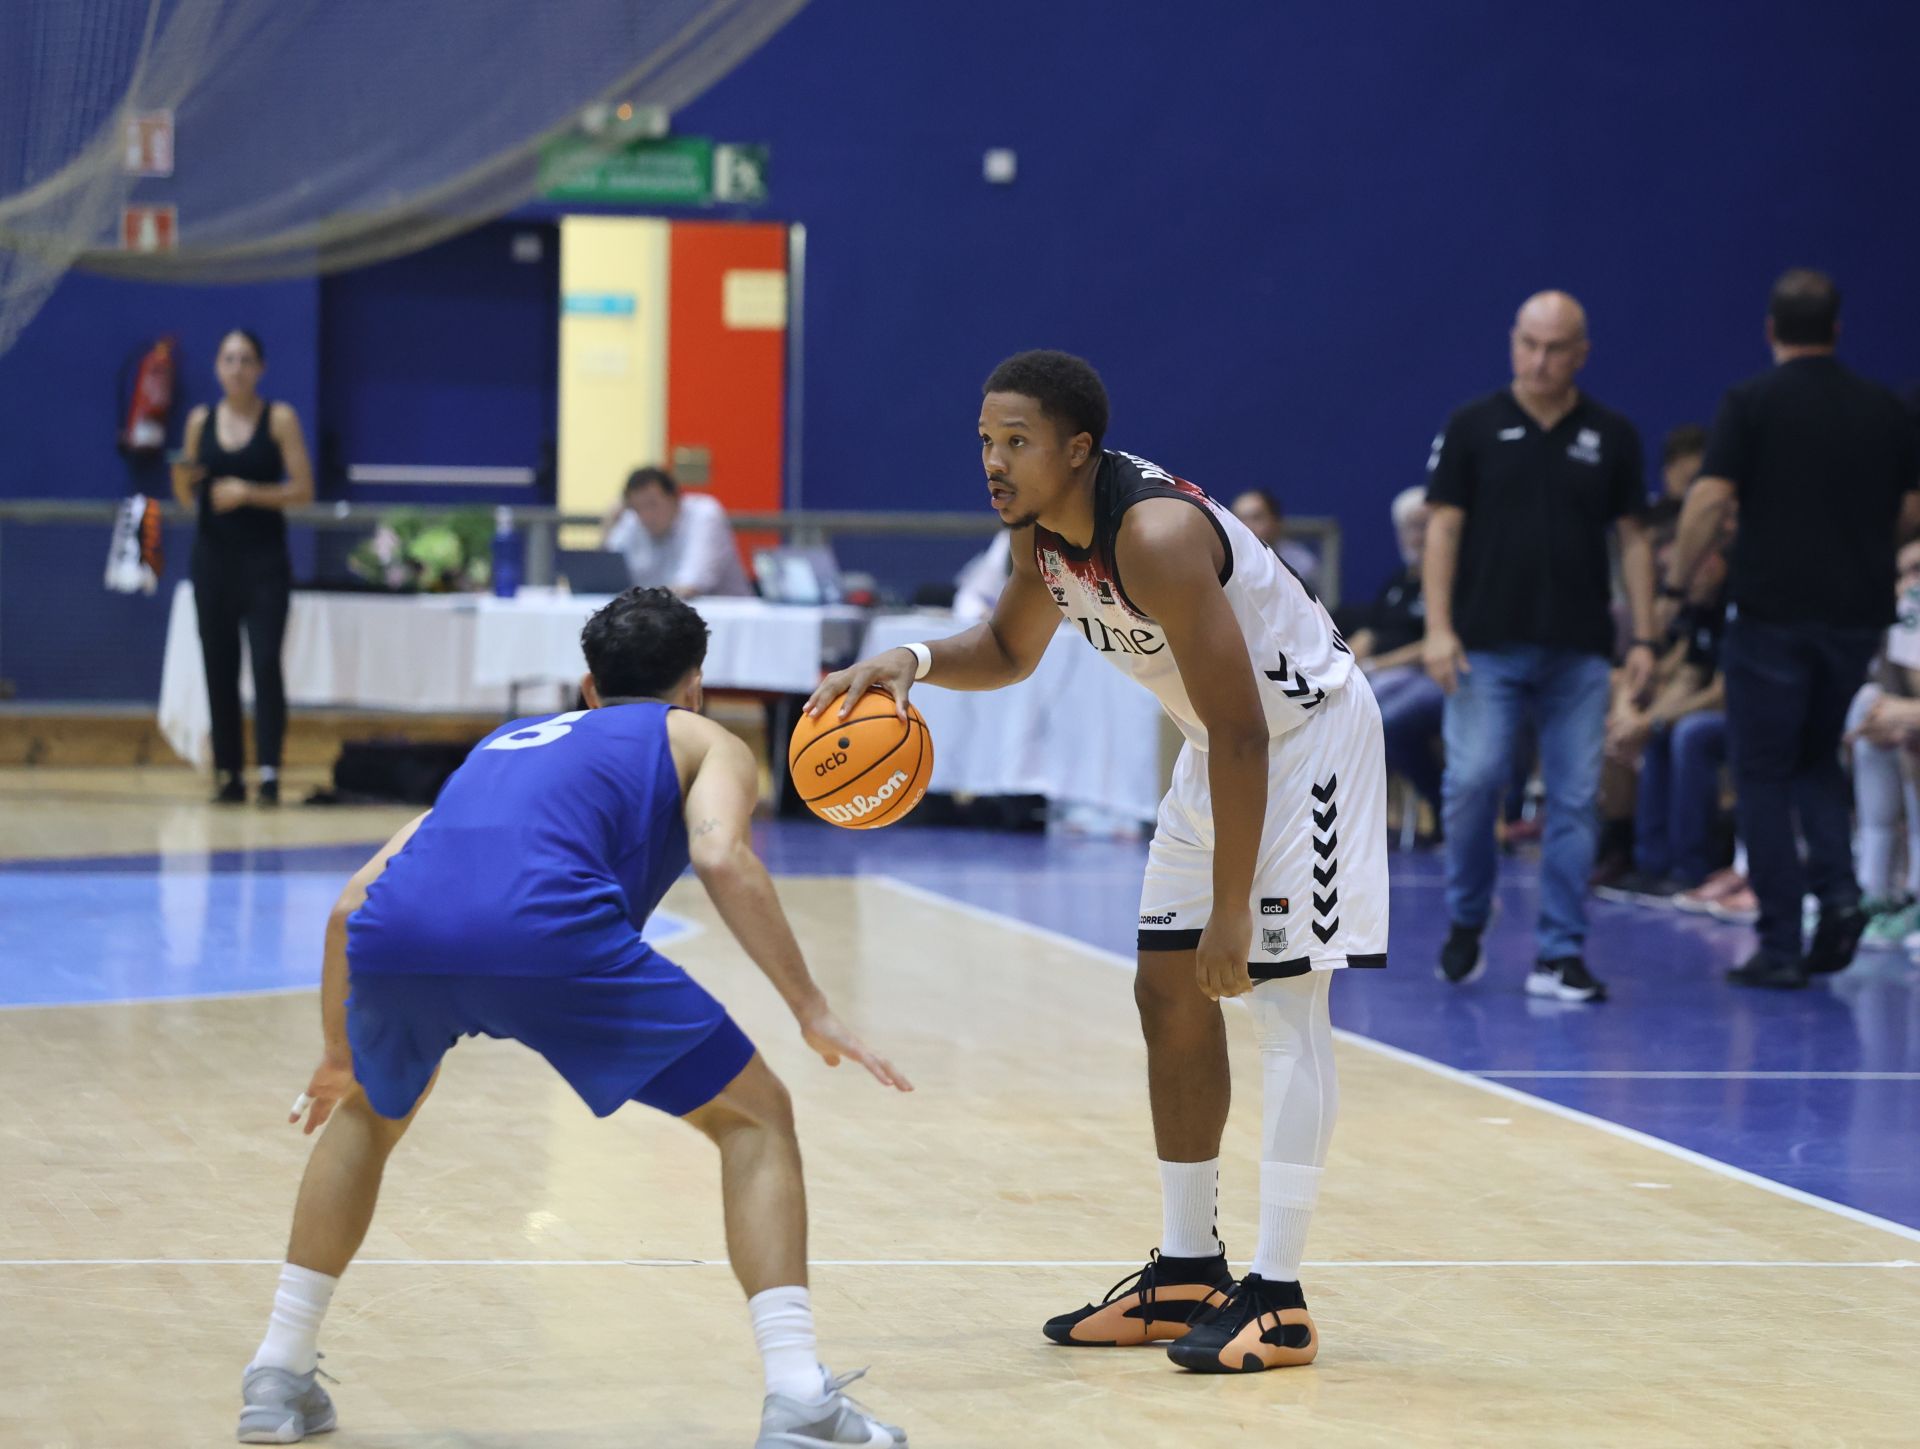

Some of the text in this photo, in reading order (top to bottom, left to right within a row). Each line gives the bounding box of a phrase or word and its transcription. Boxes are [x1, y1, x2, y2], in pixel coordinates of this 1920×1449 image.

[815, 751, 848, 777] acb
[820, 769, 909, 823] Wilson
[1262, 904, 1283, 913] acb
